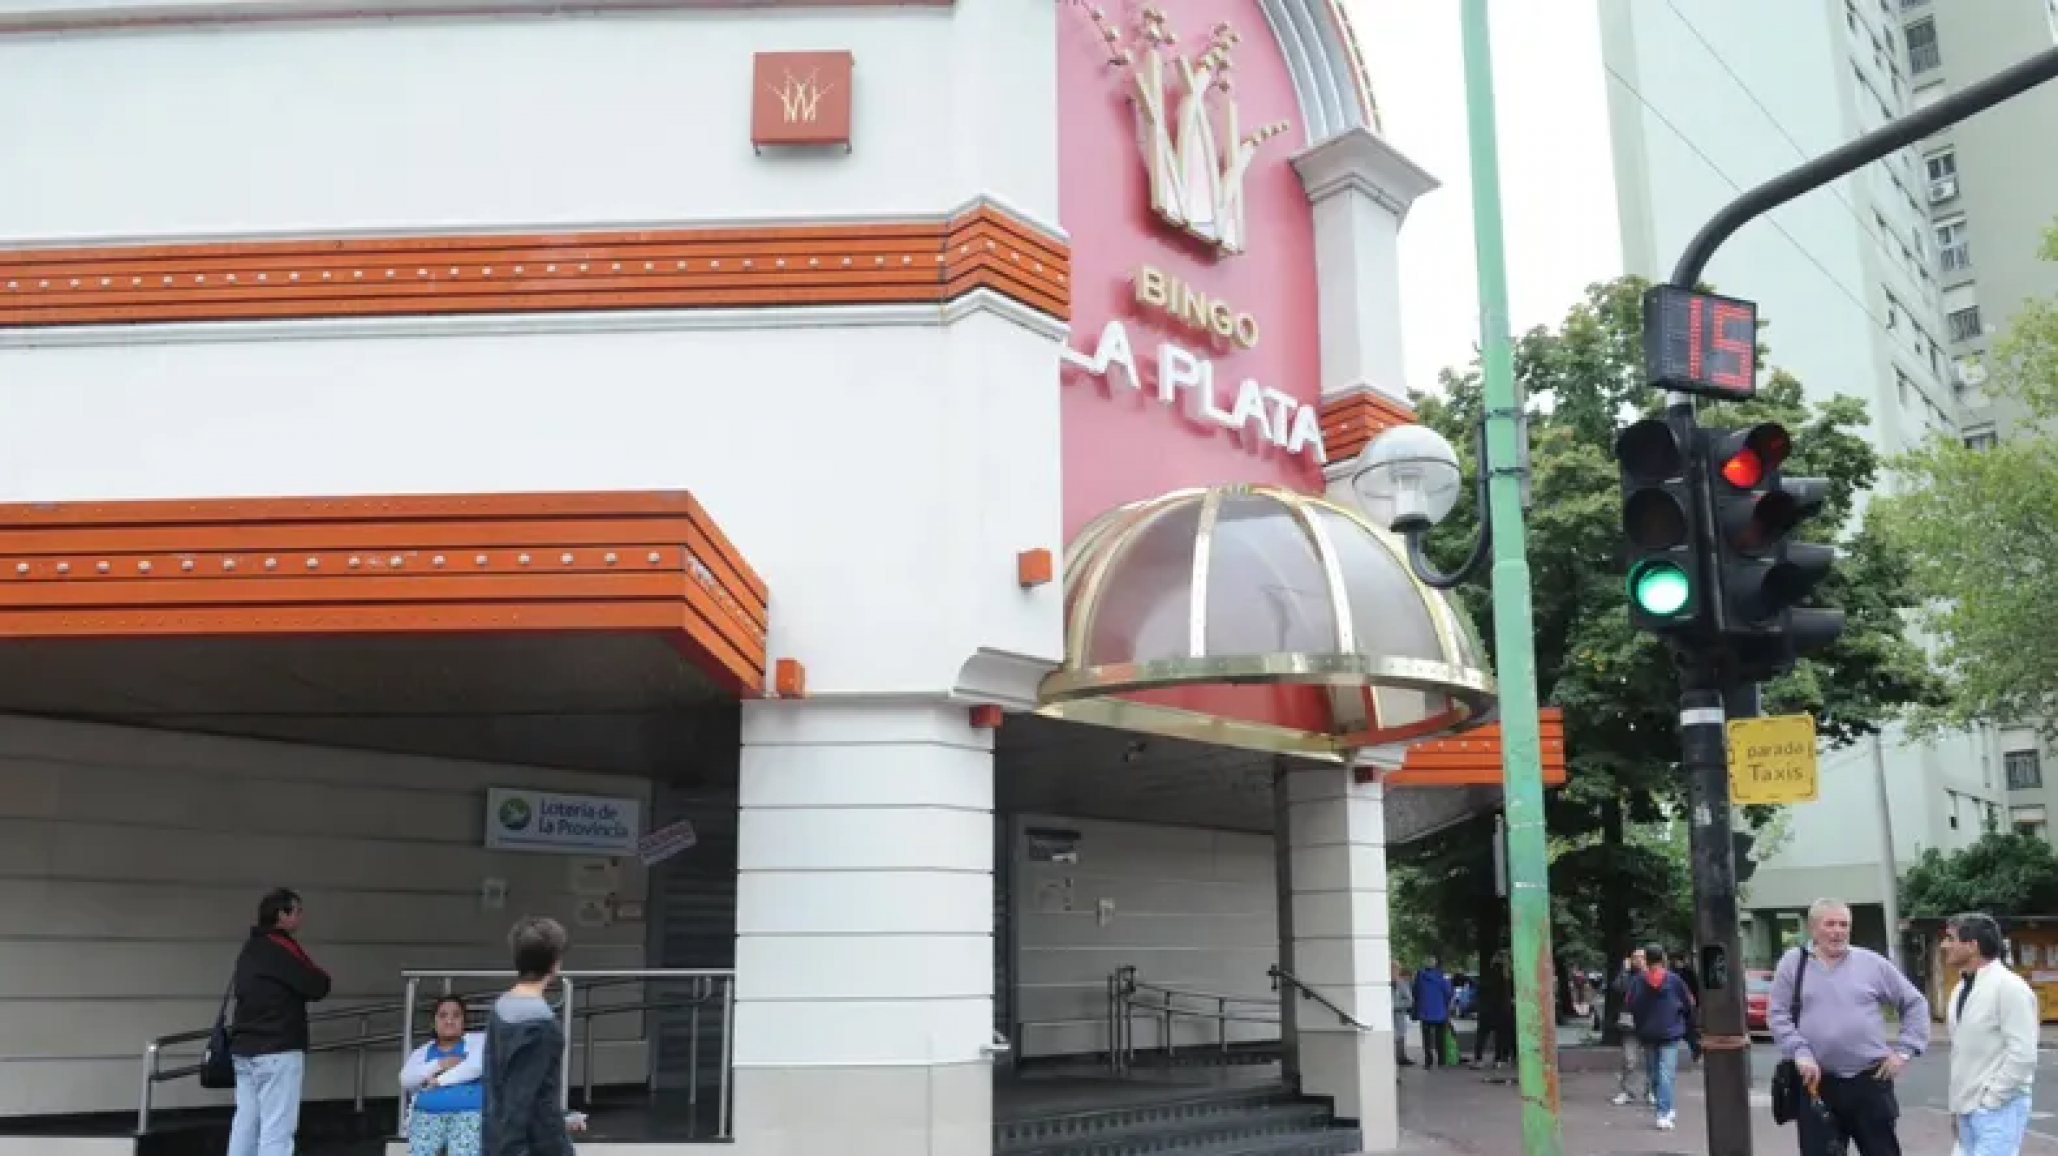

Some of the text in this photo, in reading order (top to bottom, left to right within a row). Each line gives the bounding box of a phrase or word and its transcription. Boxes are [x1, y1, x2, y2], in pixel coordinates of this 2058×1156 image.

[1135, 264, 1259, 348] BINGO
[1688, 296, 1754, 389] 15
[1158, 342, 1327, 463] PLATA
[1747, 741, 1804, 759] parada
[1747, 762, 1804, 782] Taxis
[599, 805, 618, 819] de
[557, 819, 628, 837] Provincia
